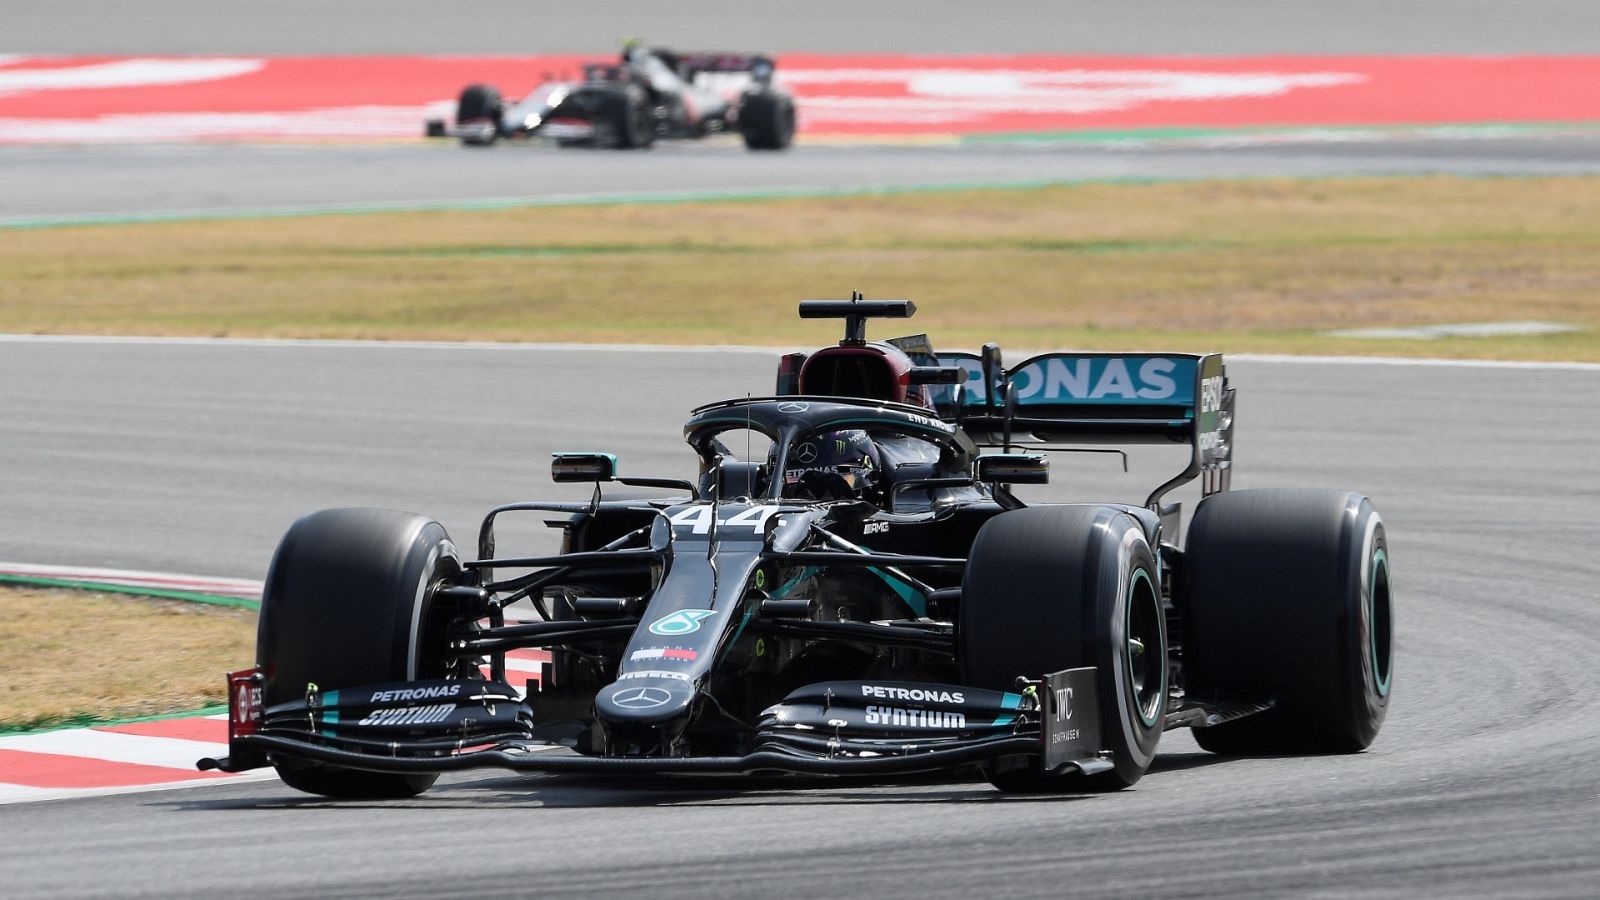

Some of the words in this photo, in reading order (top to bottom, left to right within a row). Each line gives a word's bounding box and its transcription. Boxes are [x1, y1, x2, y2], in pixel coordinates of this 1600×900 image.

[943, 357, 1177, 400] RONAS
[907, 413, 928, 425] END
[670, 505, 786, 534] 44
[370, 684, 461, 703] PETRONAS
[861, 685, 965, 704] PETRONAS
[1056, 687, 1074, 722] IWC
[358, 703, 456, 726] SYNTIUM
[864, 705, 966, 729] SYNTIUM
